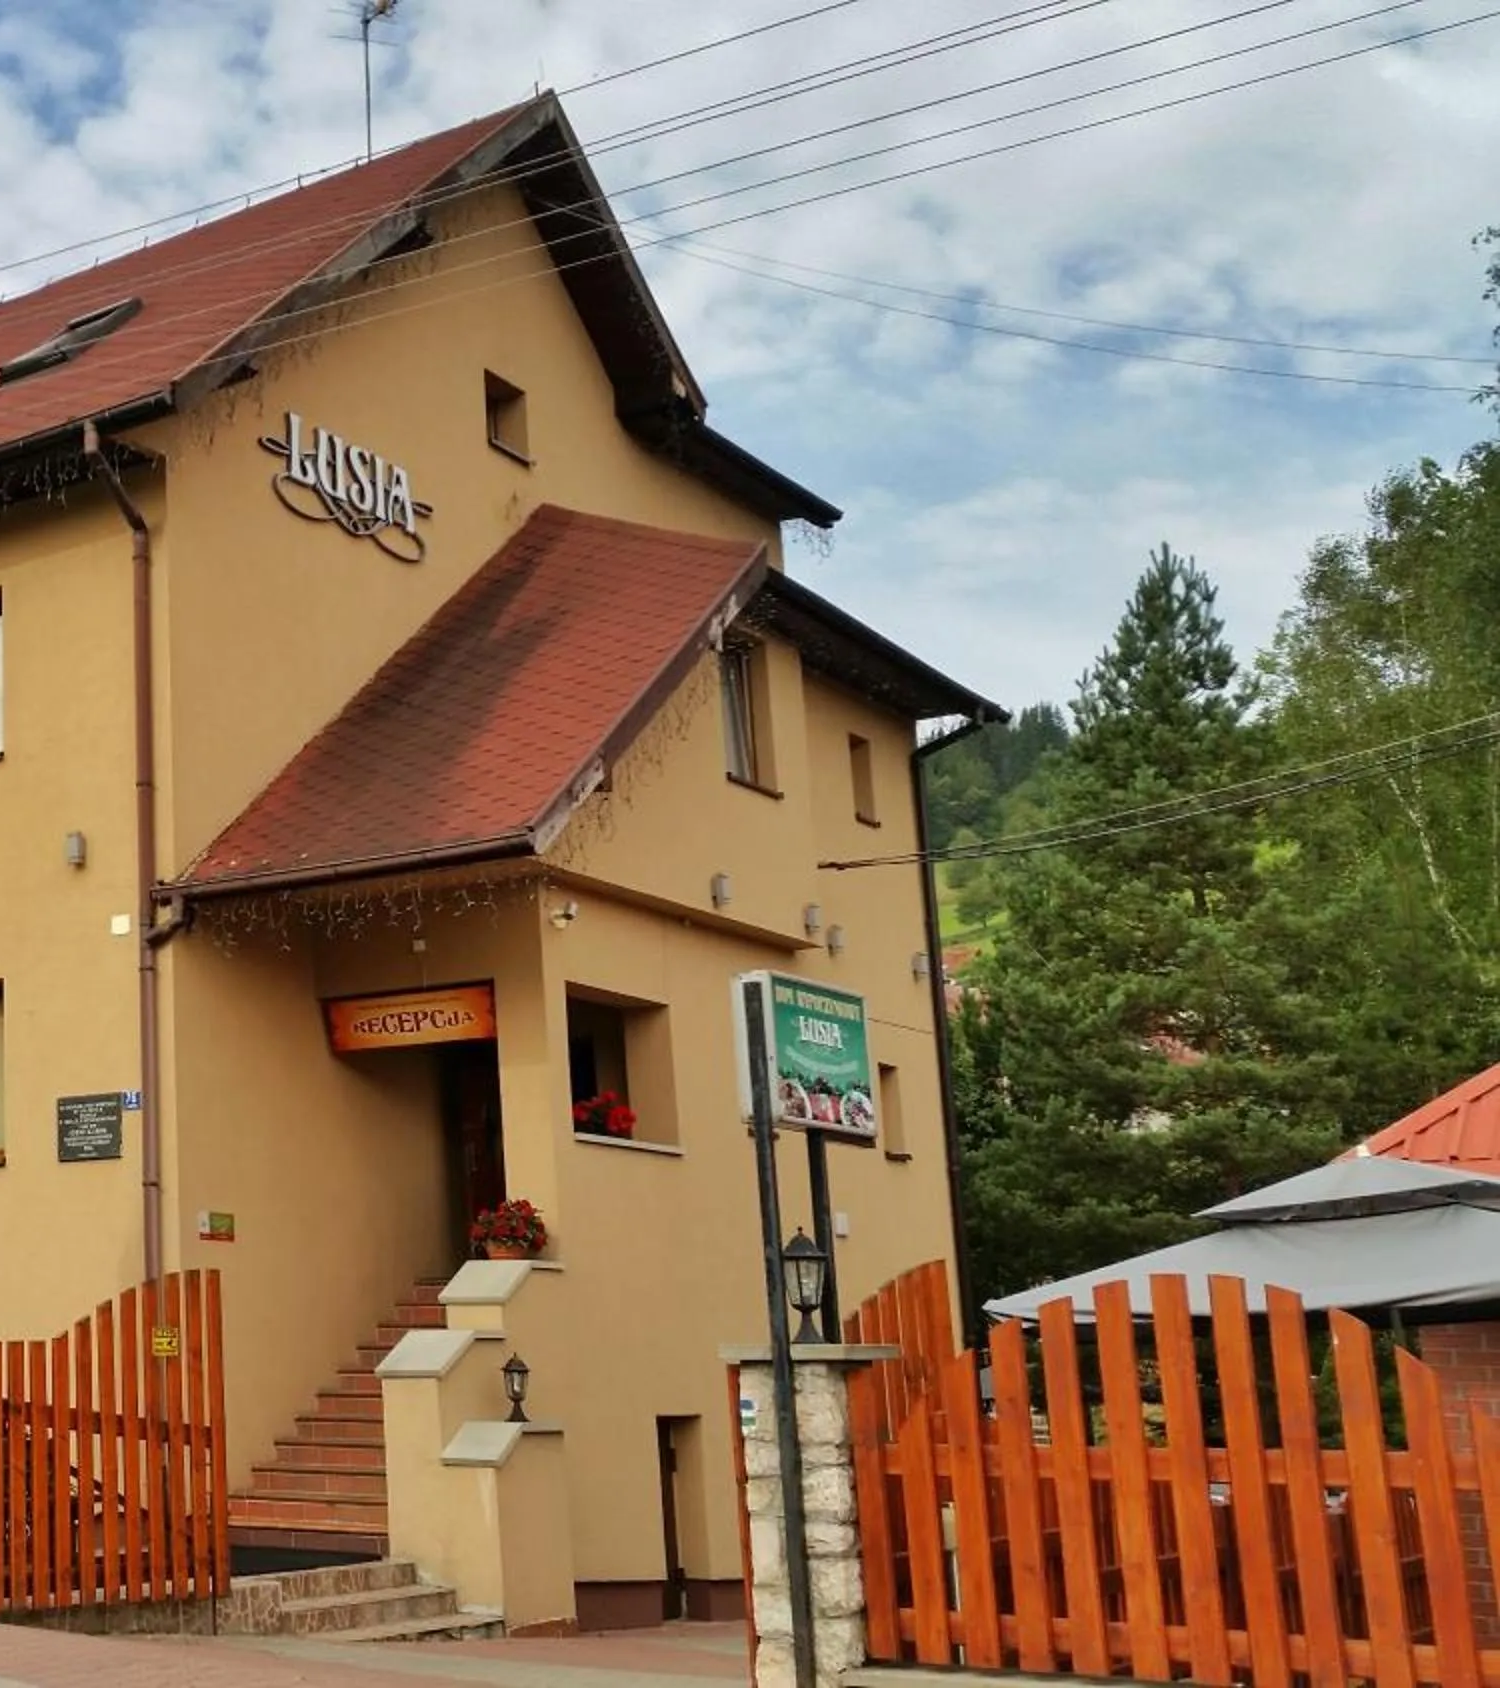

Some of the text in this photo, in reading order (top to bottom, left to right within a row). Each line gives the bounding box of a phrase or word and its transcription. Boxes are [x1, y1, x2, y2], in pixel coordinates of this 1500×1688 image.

[284, 411, 416, 534] LUSIA
[353, 1008, 476, 1034] RECEPCJA
[799, 1015, 845, 1050] LUSIA
